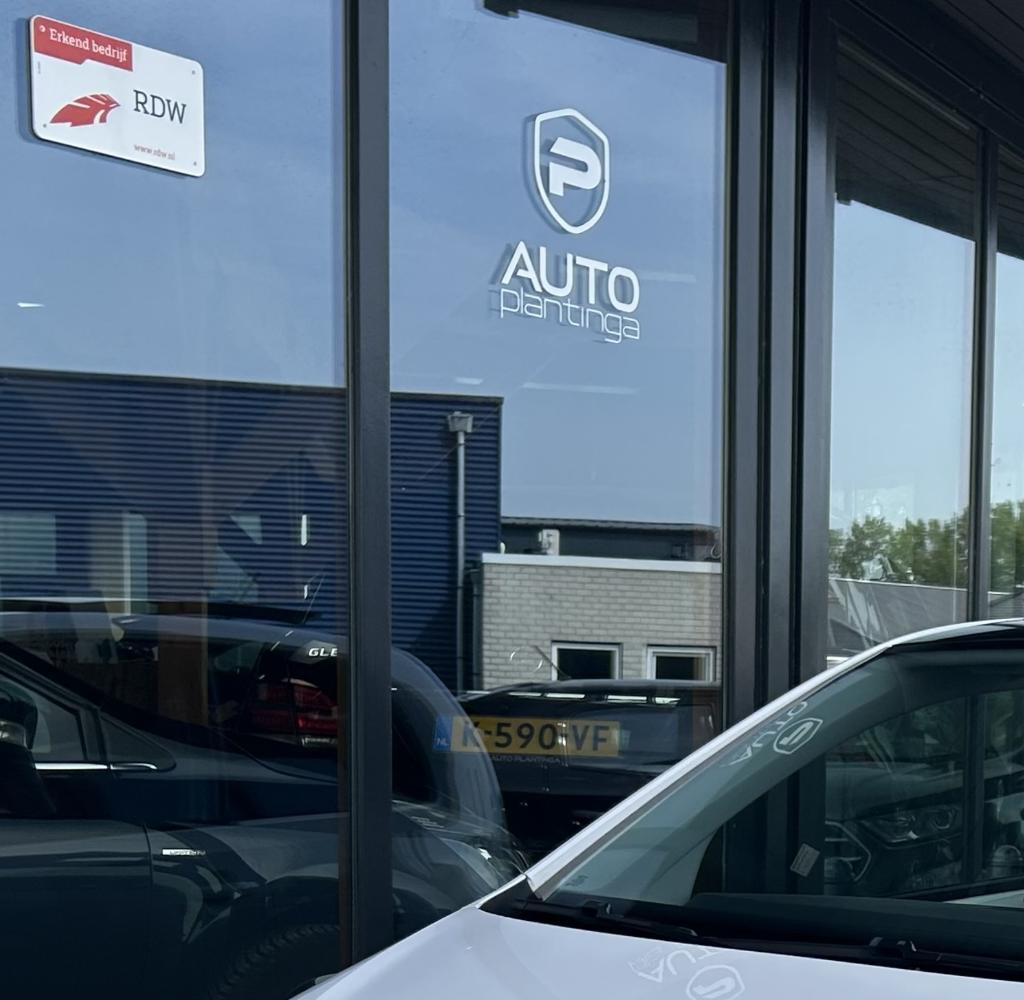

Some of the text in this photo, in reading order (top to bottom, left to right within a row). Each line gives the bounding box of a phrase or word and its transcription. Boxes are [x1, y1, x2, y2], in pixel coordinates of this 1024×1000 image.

[50, 28, 128, 62] Erkend bedrijf
[133, 89, 187, 125] RDW
[501, 240, 640, 313] AUTO
[500, 286, 640, 343] plantinga
